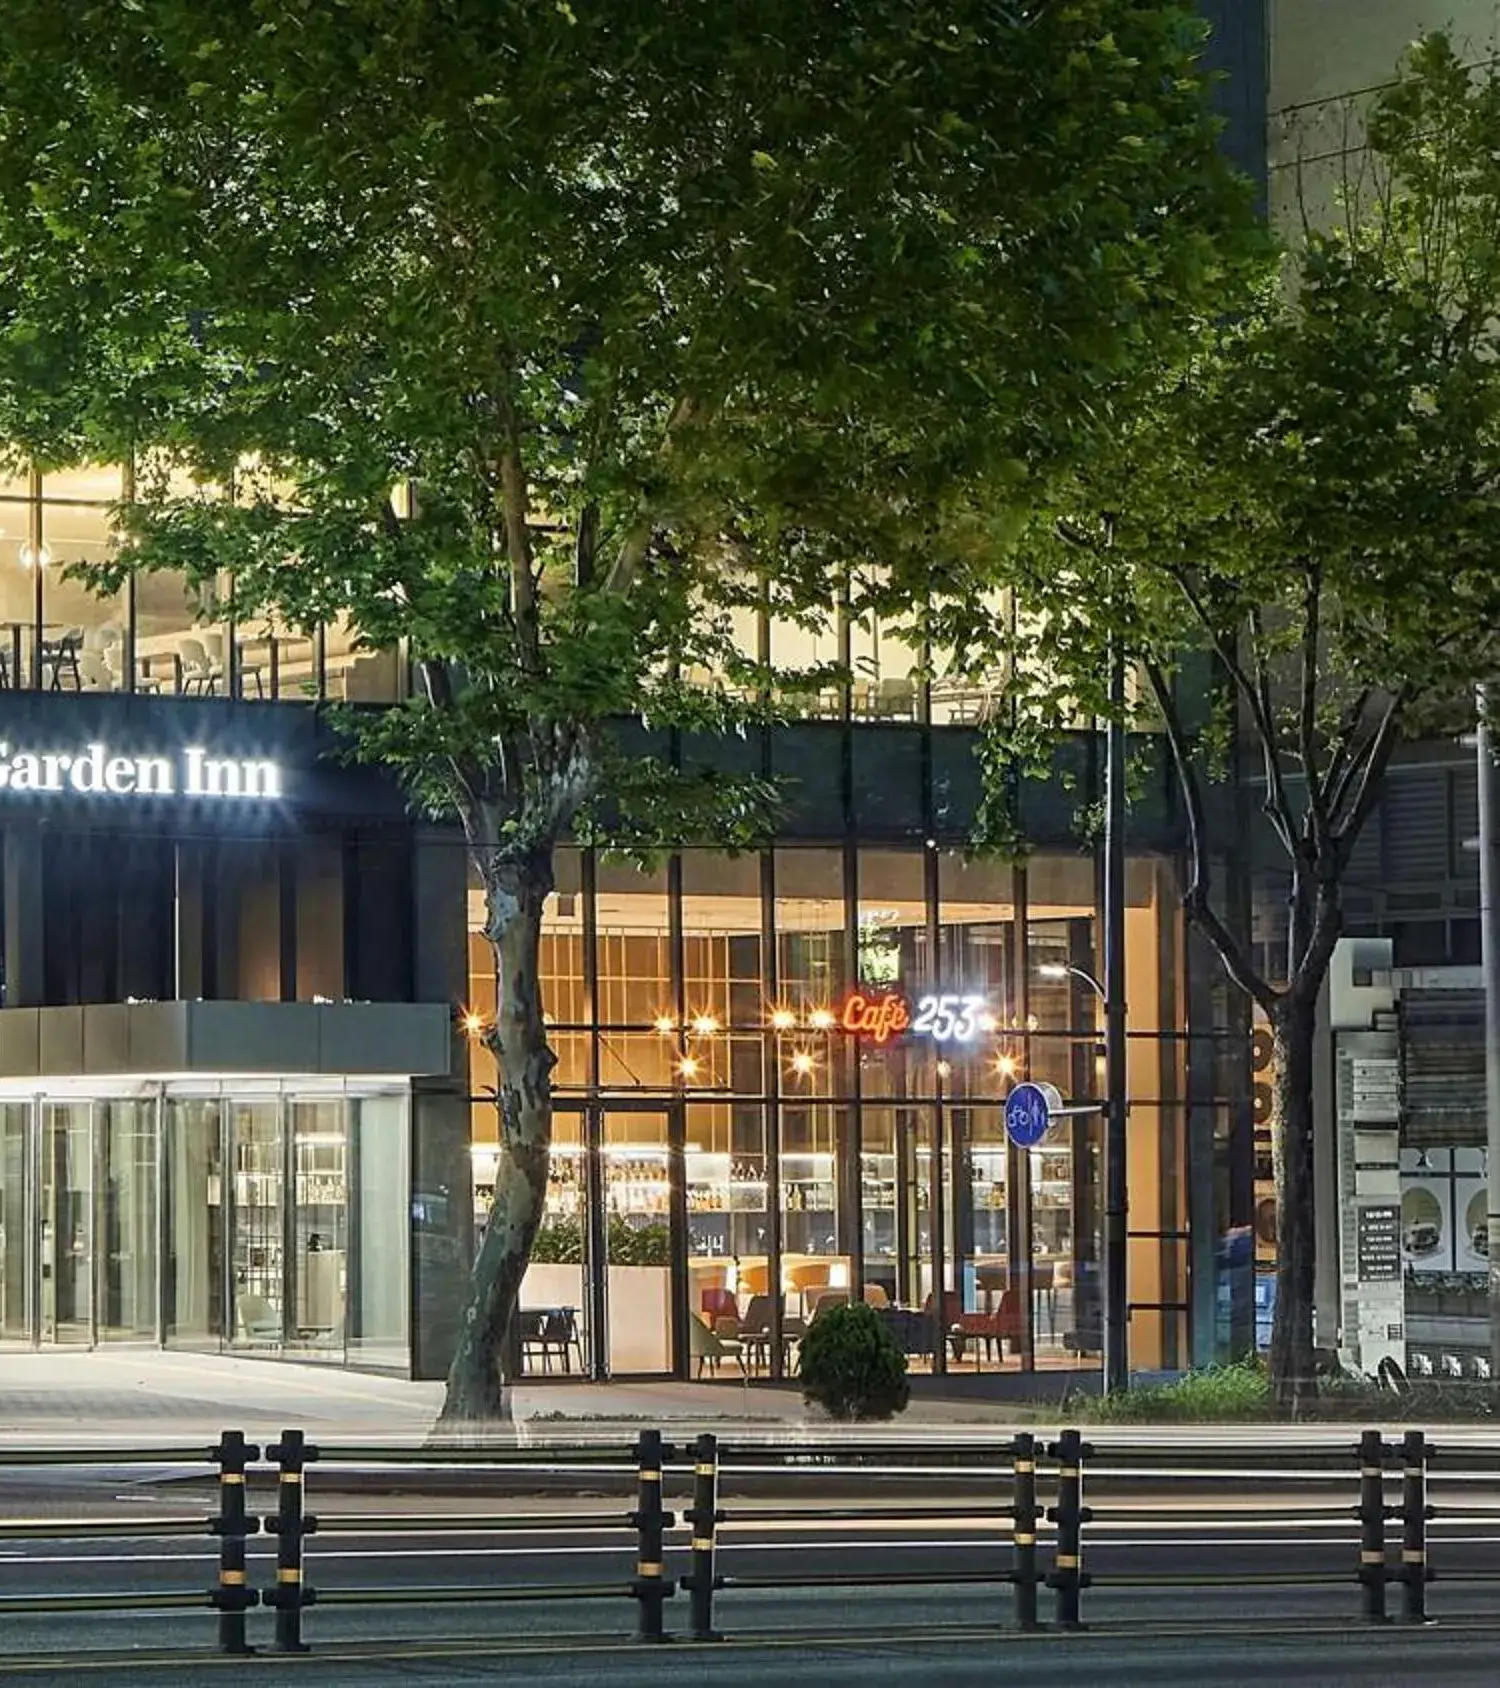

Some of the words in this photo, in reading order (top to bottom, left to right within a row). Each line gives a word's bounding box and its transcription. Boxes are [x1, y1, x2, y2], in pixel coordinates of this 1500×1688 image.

[184, 747, 283, 798] Inn
[843, 994, 909, 1042] Café
[914, 996, 985, 1041] 253
